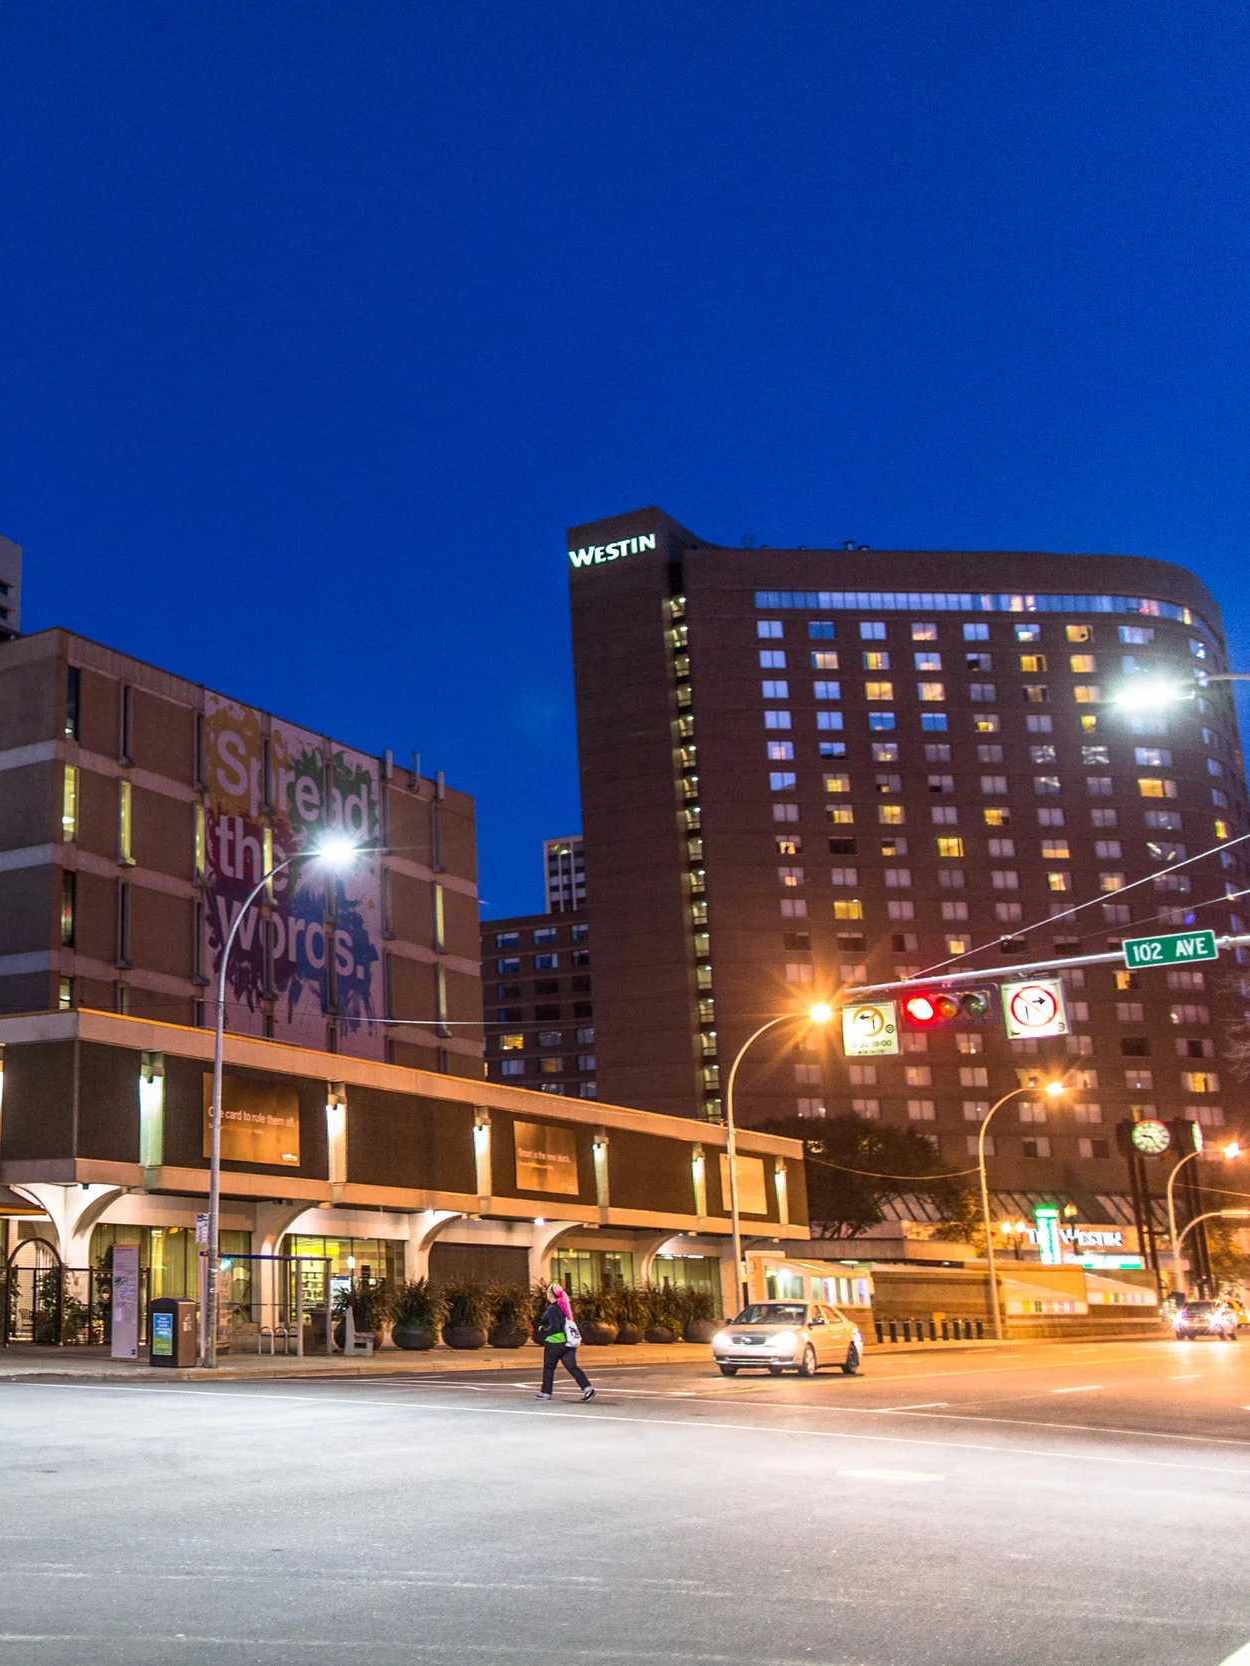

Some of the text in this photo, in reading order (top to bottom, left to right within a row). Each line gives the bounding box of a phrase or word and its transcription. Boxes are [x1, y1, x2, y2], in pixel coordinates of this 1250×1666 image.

[568, 533, 656, 568] WESTIN
[216, 815, 292, 892] the
[1132, 937, 1209, 962] 102 AVE
[208, 1106, 224, 1118] Oe
[225, 1110, 242, 1120] card
[243, 1111, 251, 1121] to
[252, 1113, 266, 1123] rule
[267, 1115, 285, 1126] them
